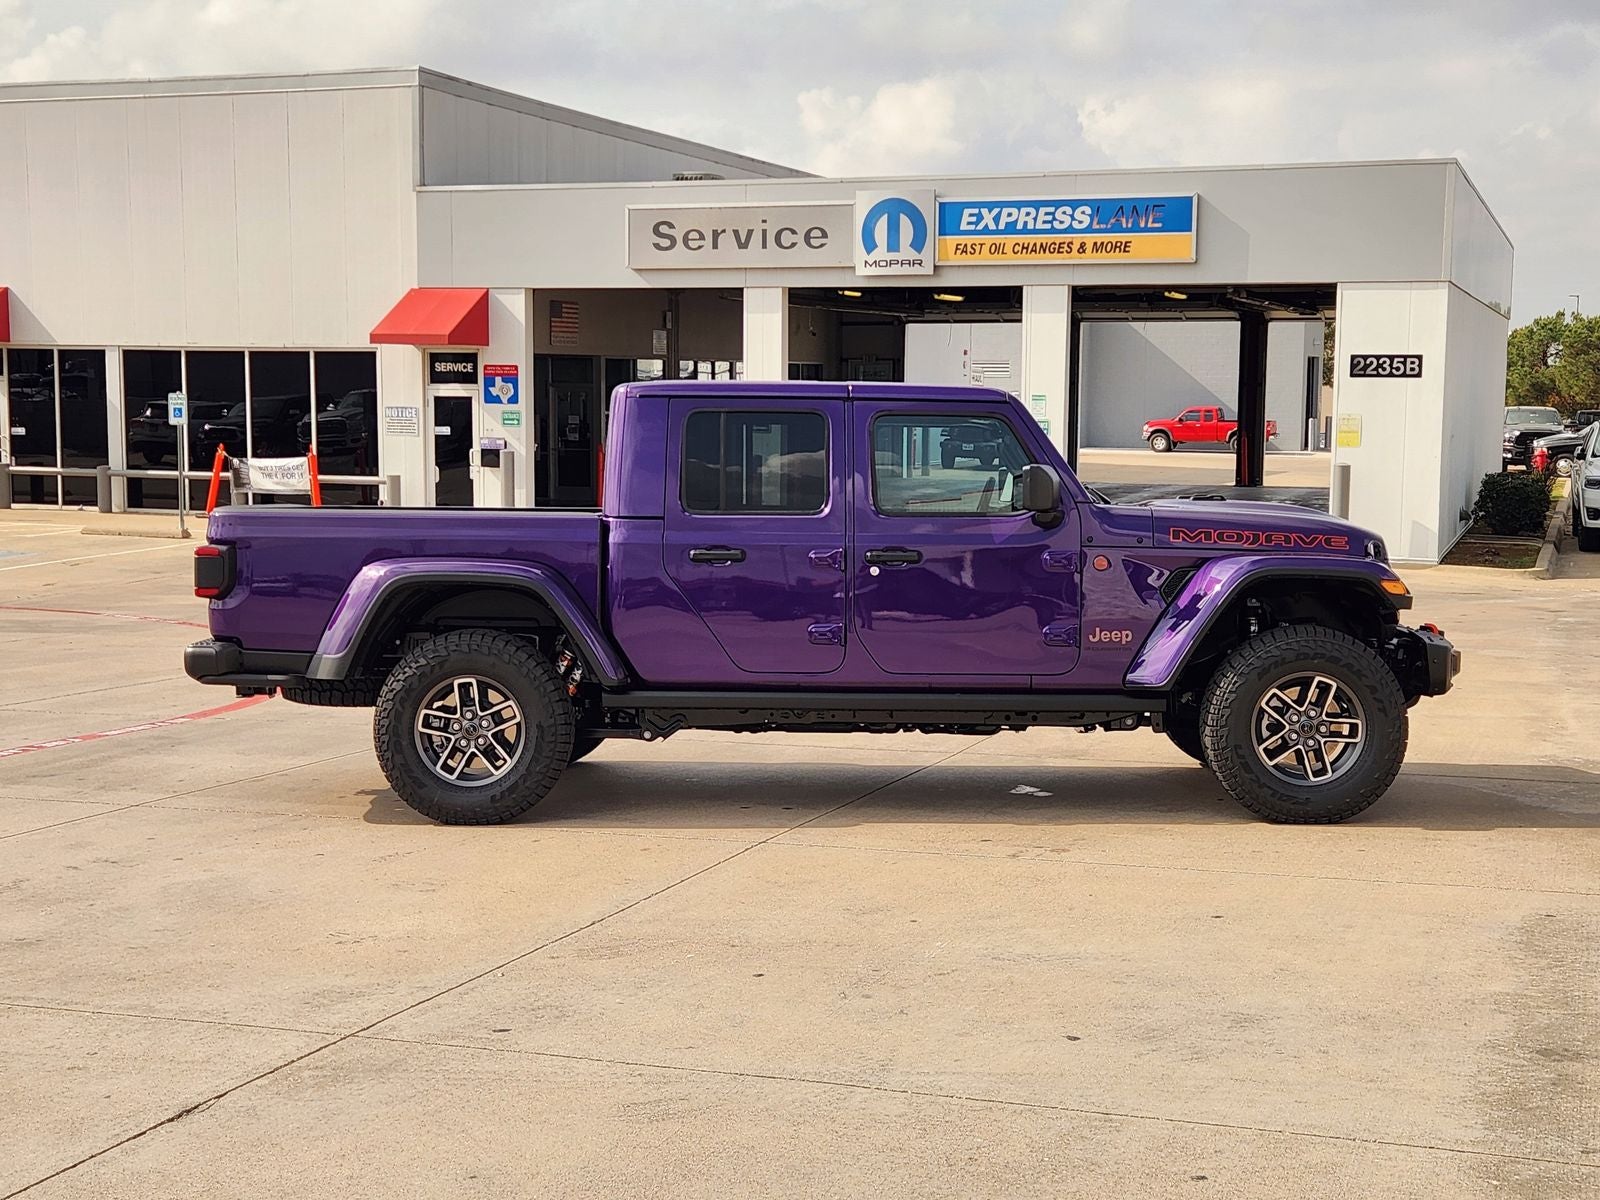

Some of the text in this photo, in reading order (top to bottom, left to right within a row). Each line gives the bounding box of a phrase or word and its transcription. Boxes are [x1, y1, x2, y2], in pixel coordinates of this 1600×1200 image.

[652, 219, 828, 251] Service
[954, 240, 1132, 256] FAST OIL CHANGES & MORE
[864, 259, 925, 269] MOPAR
[434, 362, 474, 373] SERVICE
[1352, 357, 1420, 375] 2235B
[385, 408, 417, 418] NOTICE
[282, 472, 296, 480] FOR
[1170, 527, 1350, 550] MOJAVE
[1088, 627, 1132, 644] Jeep
